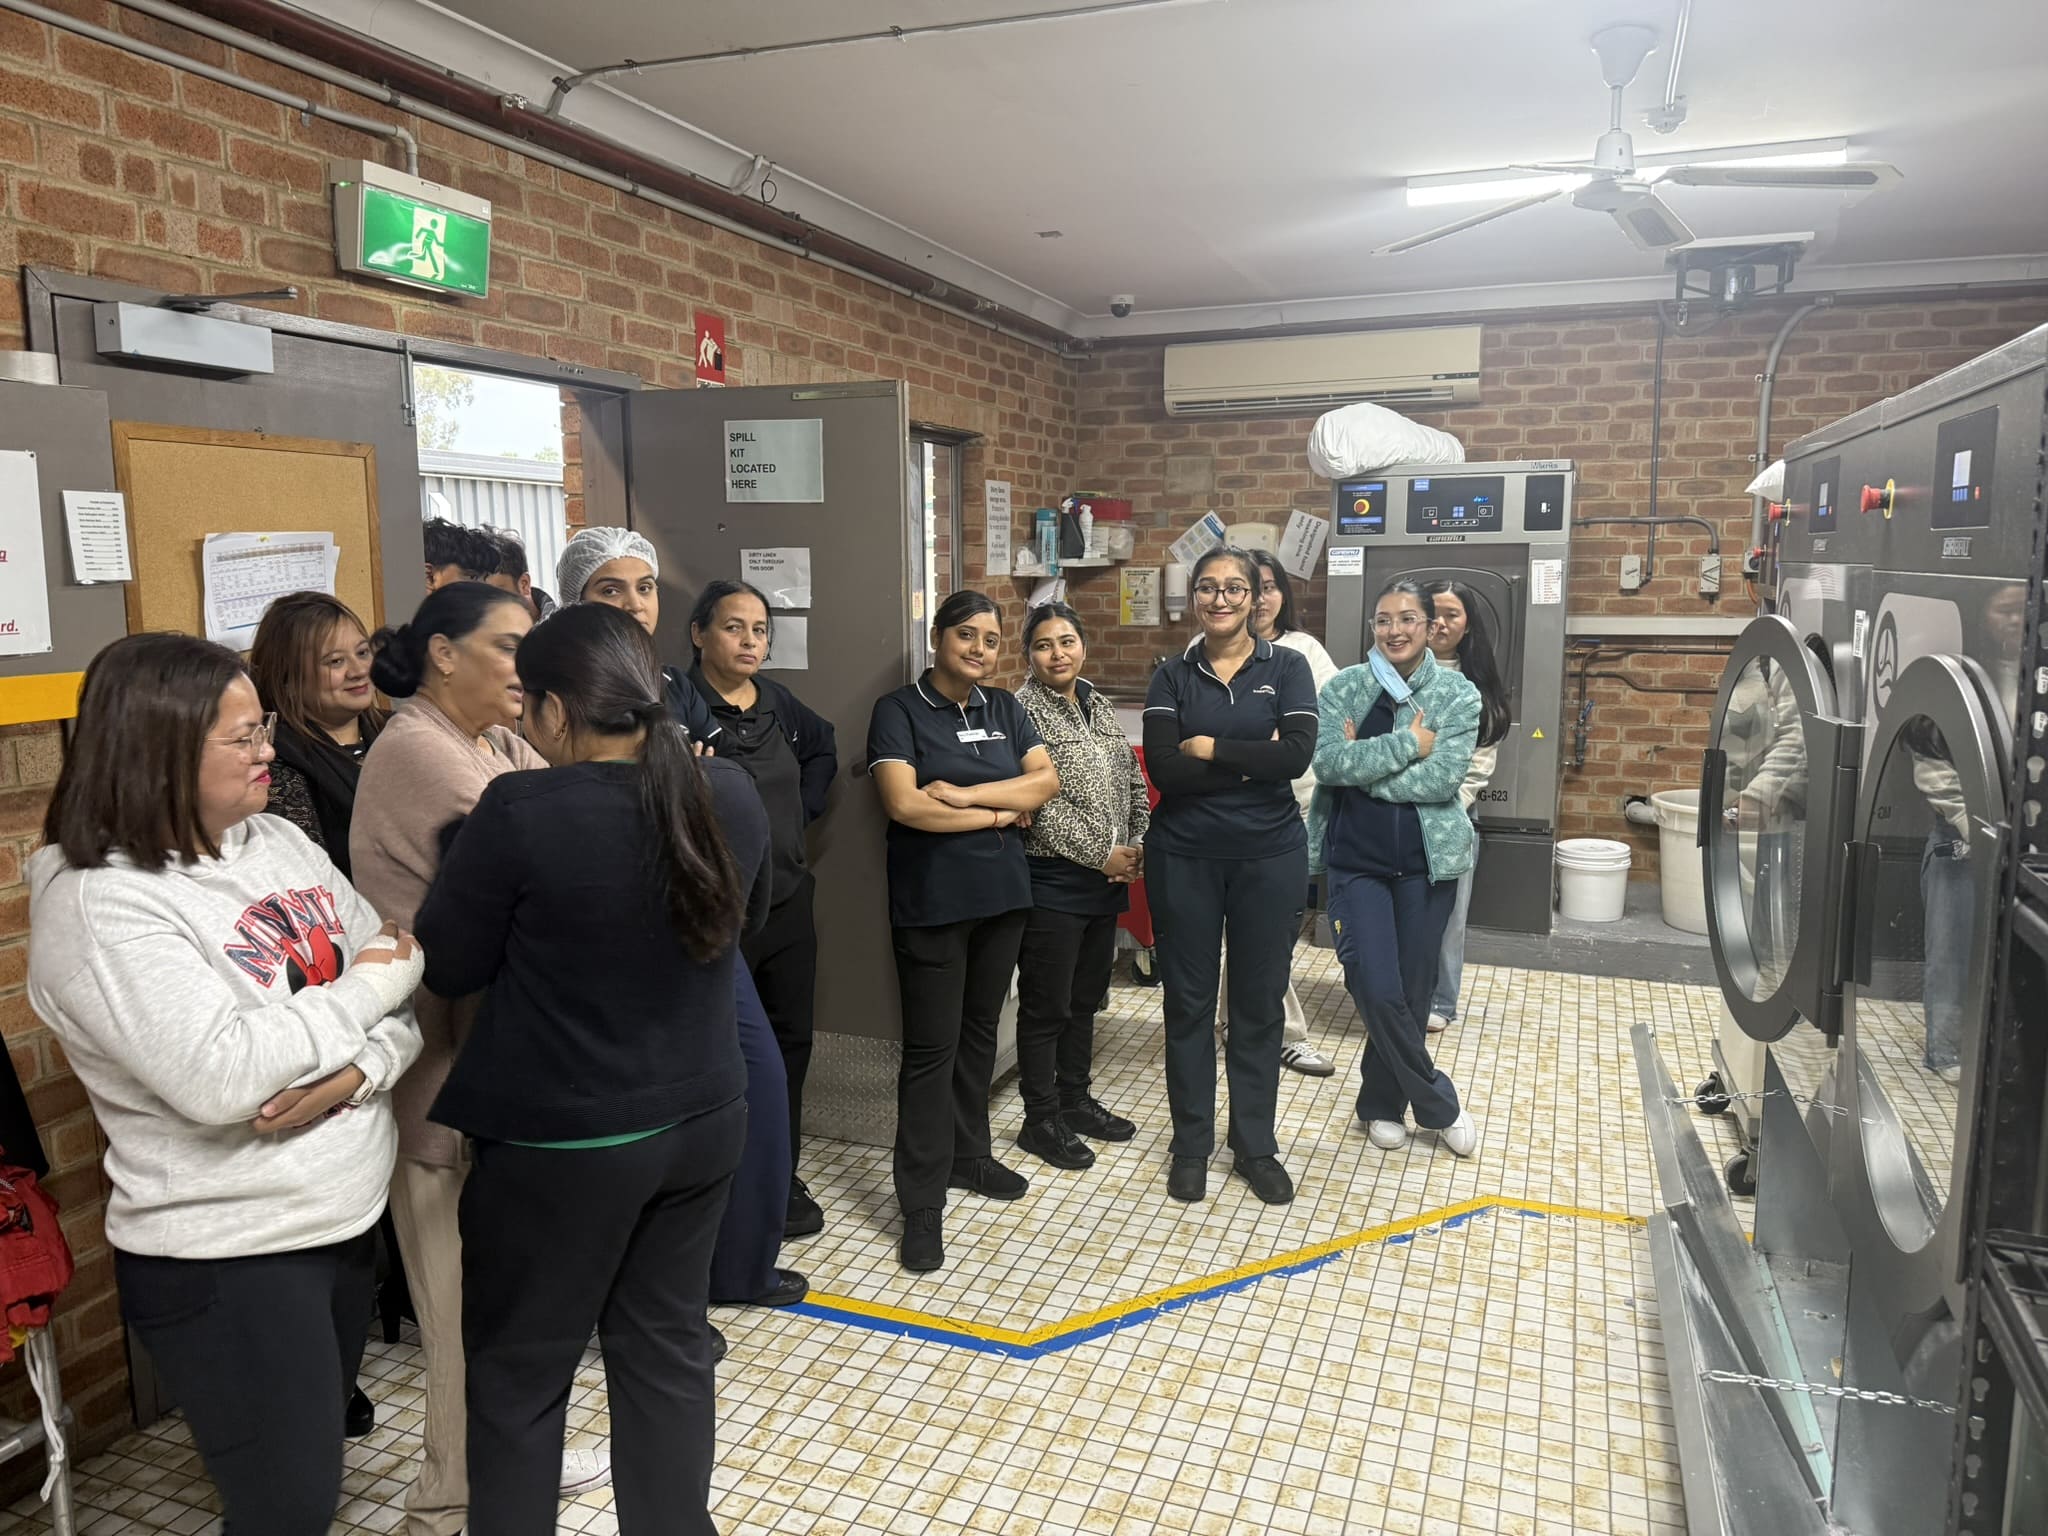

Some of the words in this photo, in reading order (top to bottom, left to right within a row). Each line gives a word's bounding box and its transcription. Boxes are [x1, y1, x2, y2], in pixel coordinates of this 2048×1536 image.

[729, 432, 757, 442] SPILL
[730, 448, 745, 458] KIT
[730, 463, 777, 473] LOCATED
[731, 479, 757, 489] HERE
[223, 885, 345, 989] MINNI
